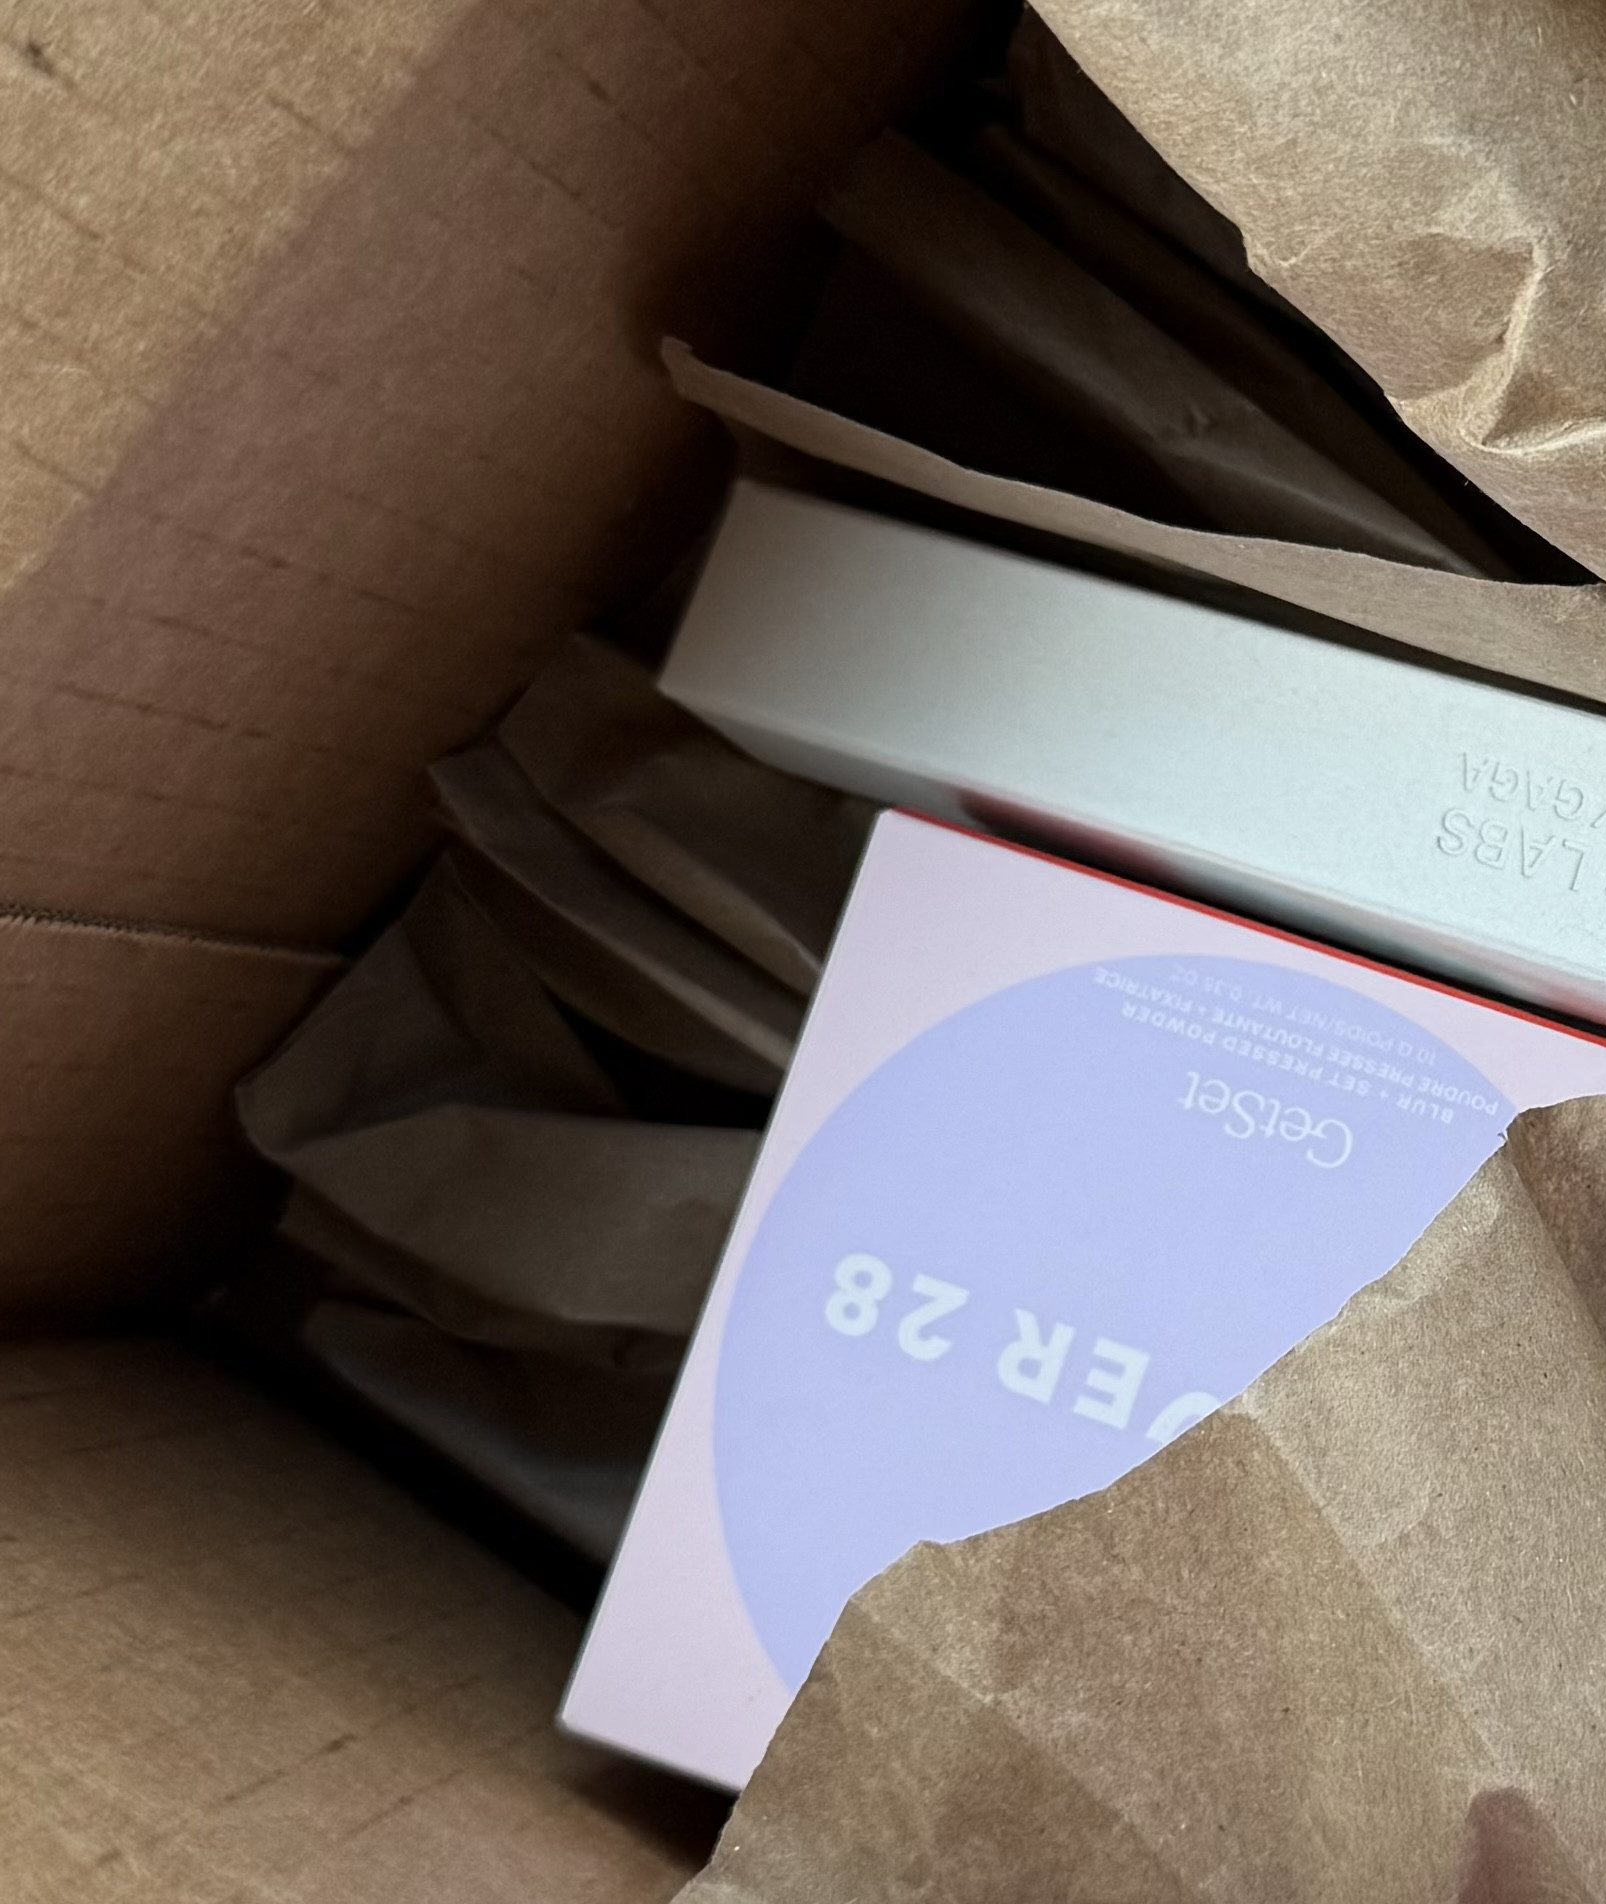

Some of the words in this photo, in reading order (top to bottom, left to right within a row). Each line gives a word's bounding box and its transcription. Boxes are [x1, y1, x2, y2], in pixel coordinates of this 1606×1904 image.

[1458, 751, 1585, 823] GAGA
[1435, 807, 1588, 893] LABS
[1092, 965, 1195, 1014] FIXATRICE
[1118, 1000, 1217, 1046] POWDER
[1210, 1006, 1326, 1056] FLOUTANTE
[1220, 1034, 1323, 1080] PRESSED
[1414, 1045, 1438, 1066] 10
[1325, 1069, 1371, 1097] SET
[1416, 1075, 1500, 1115] POUDRE
[1176, 1069, 1352, 1169] GetSet
[1395, 1092, 1456, 1124] BLUR
[822, 1252, 970, 1360] 28
[996, 1306, 1221, 1441] ER
